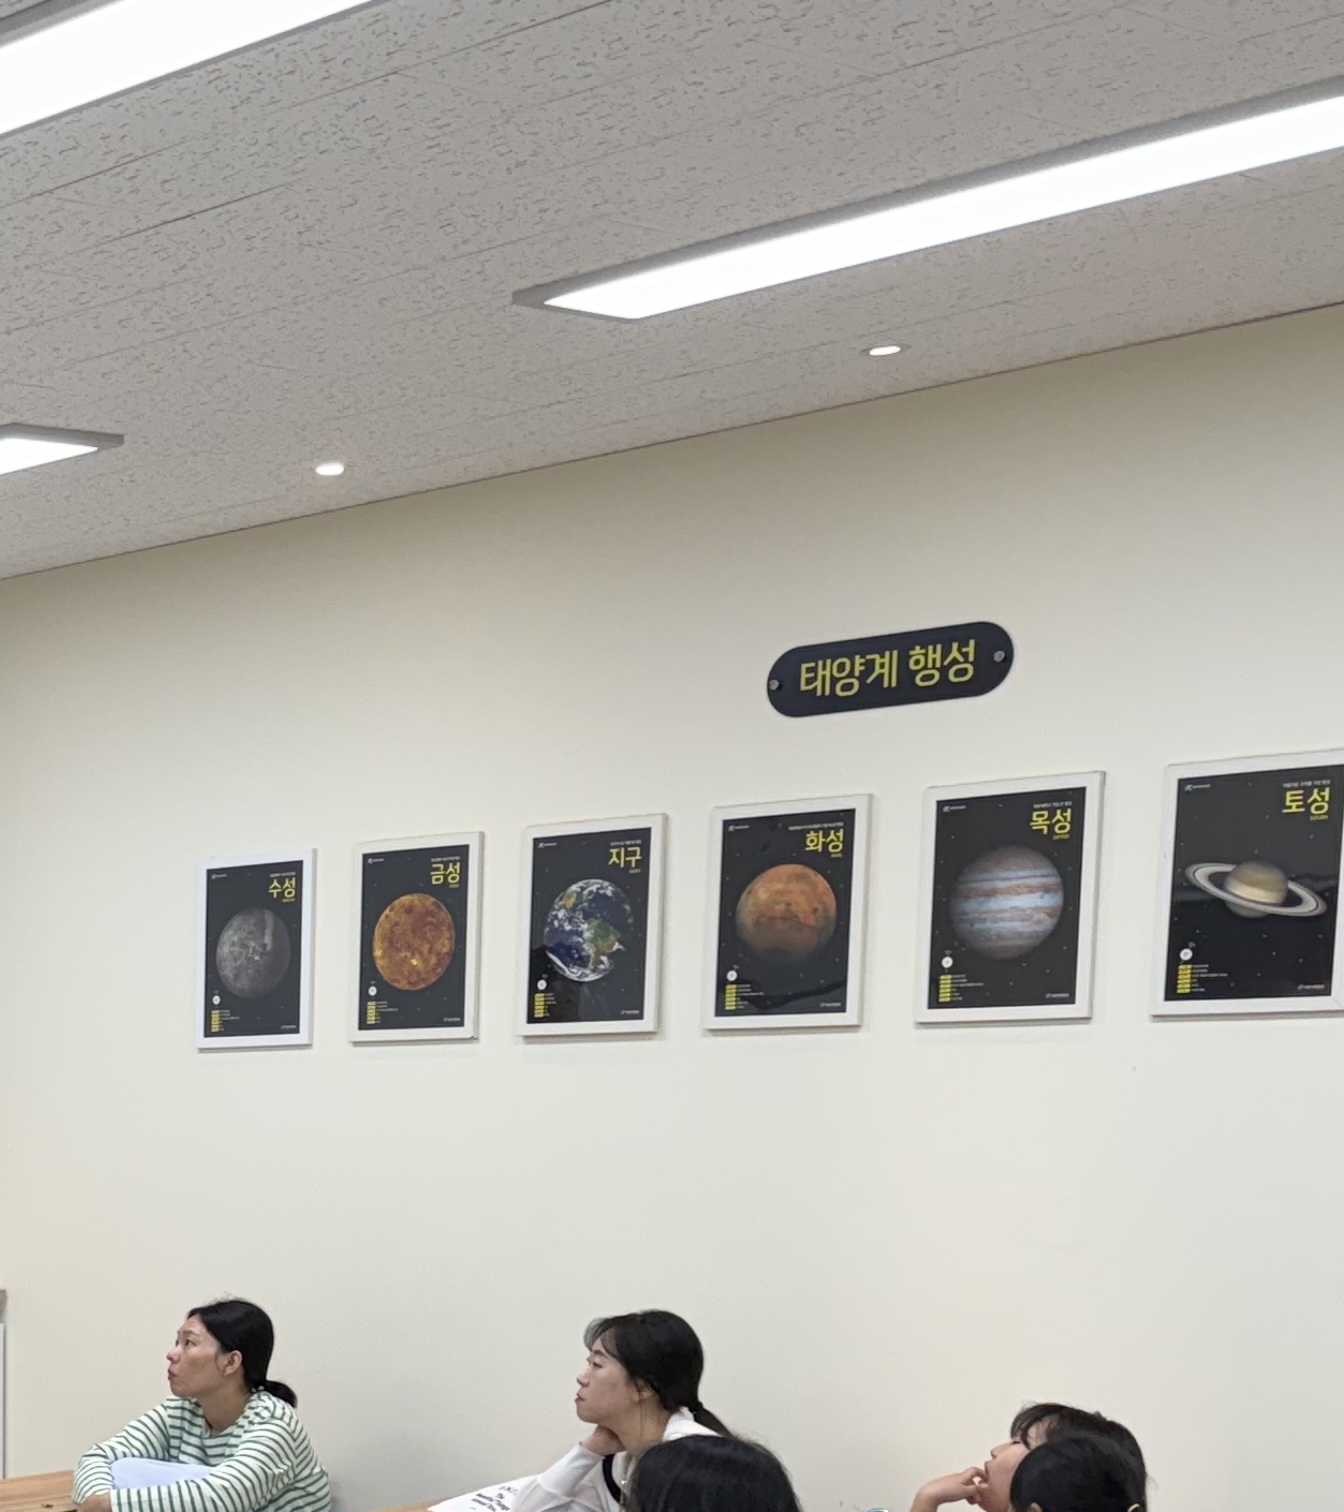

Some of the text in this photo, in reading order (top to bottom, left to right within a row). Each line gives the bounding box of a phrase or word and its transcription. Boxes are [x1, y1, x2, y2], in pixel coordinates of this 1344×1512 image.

[799, 639, 976, 697] 태양계 행성
[1282, 787, 1330, 814] 토성
[1029, 808, 1072, 835] 목성
[805, 828, 844, 853] 화성
[608, 846, 642, 868] 지구
[430, 861, 461, 885] 금성
[268, 876, 296, 899] 수성
